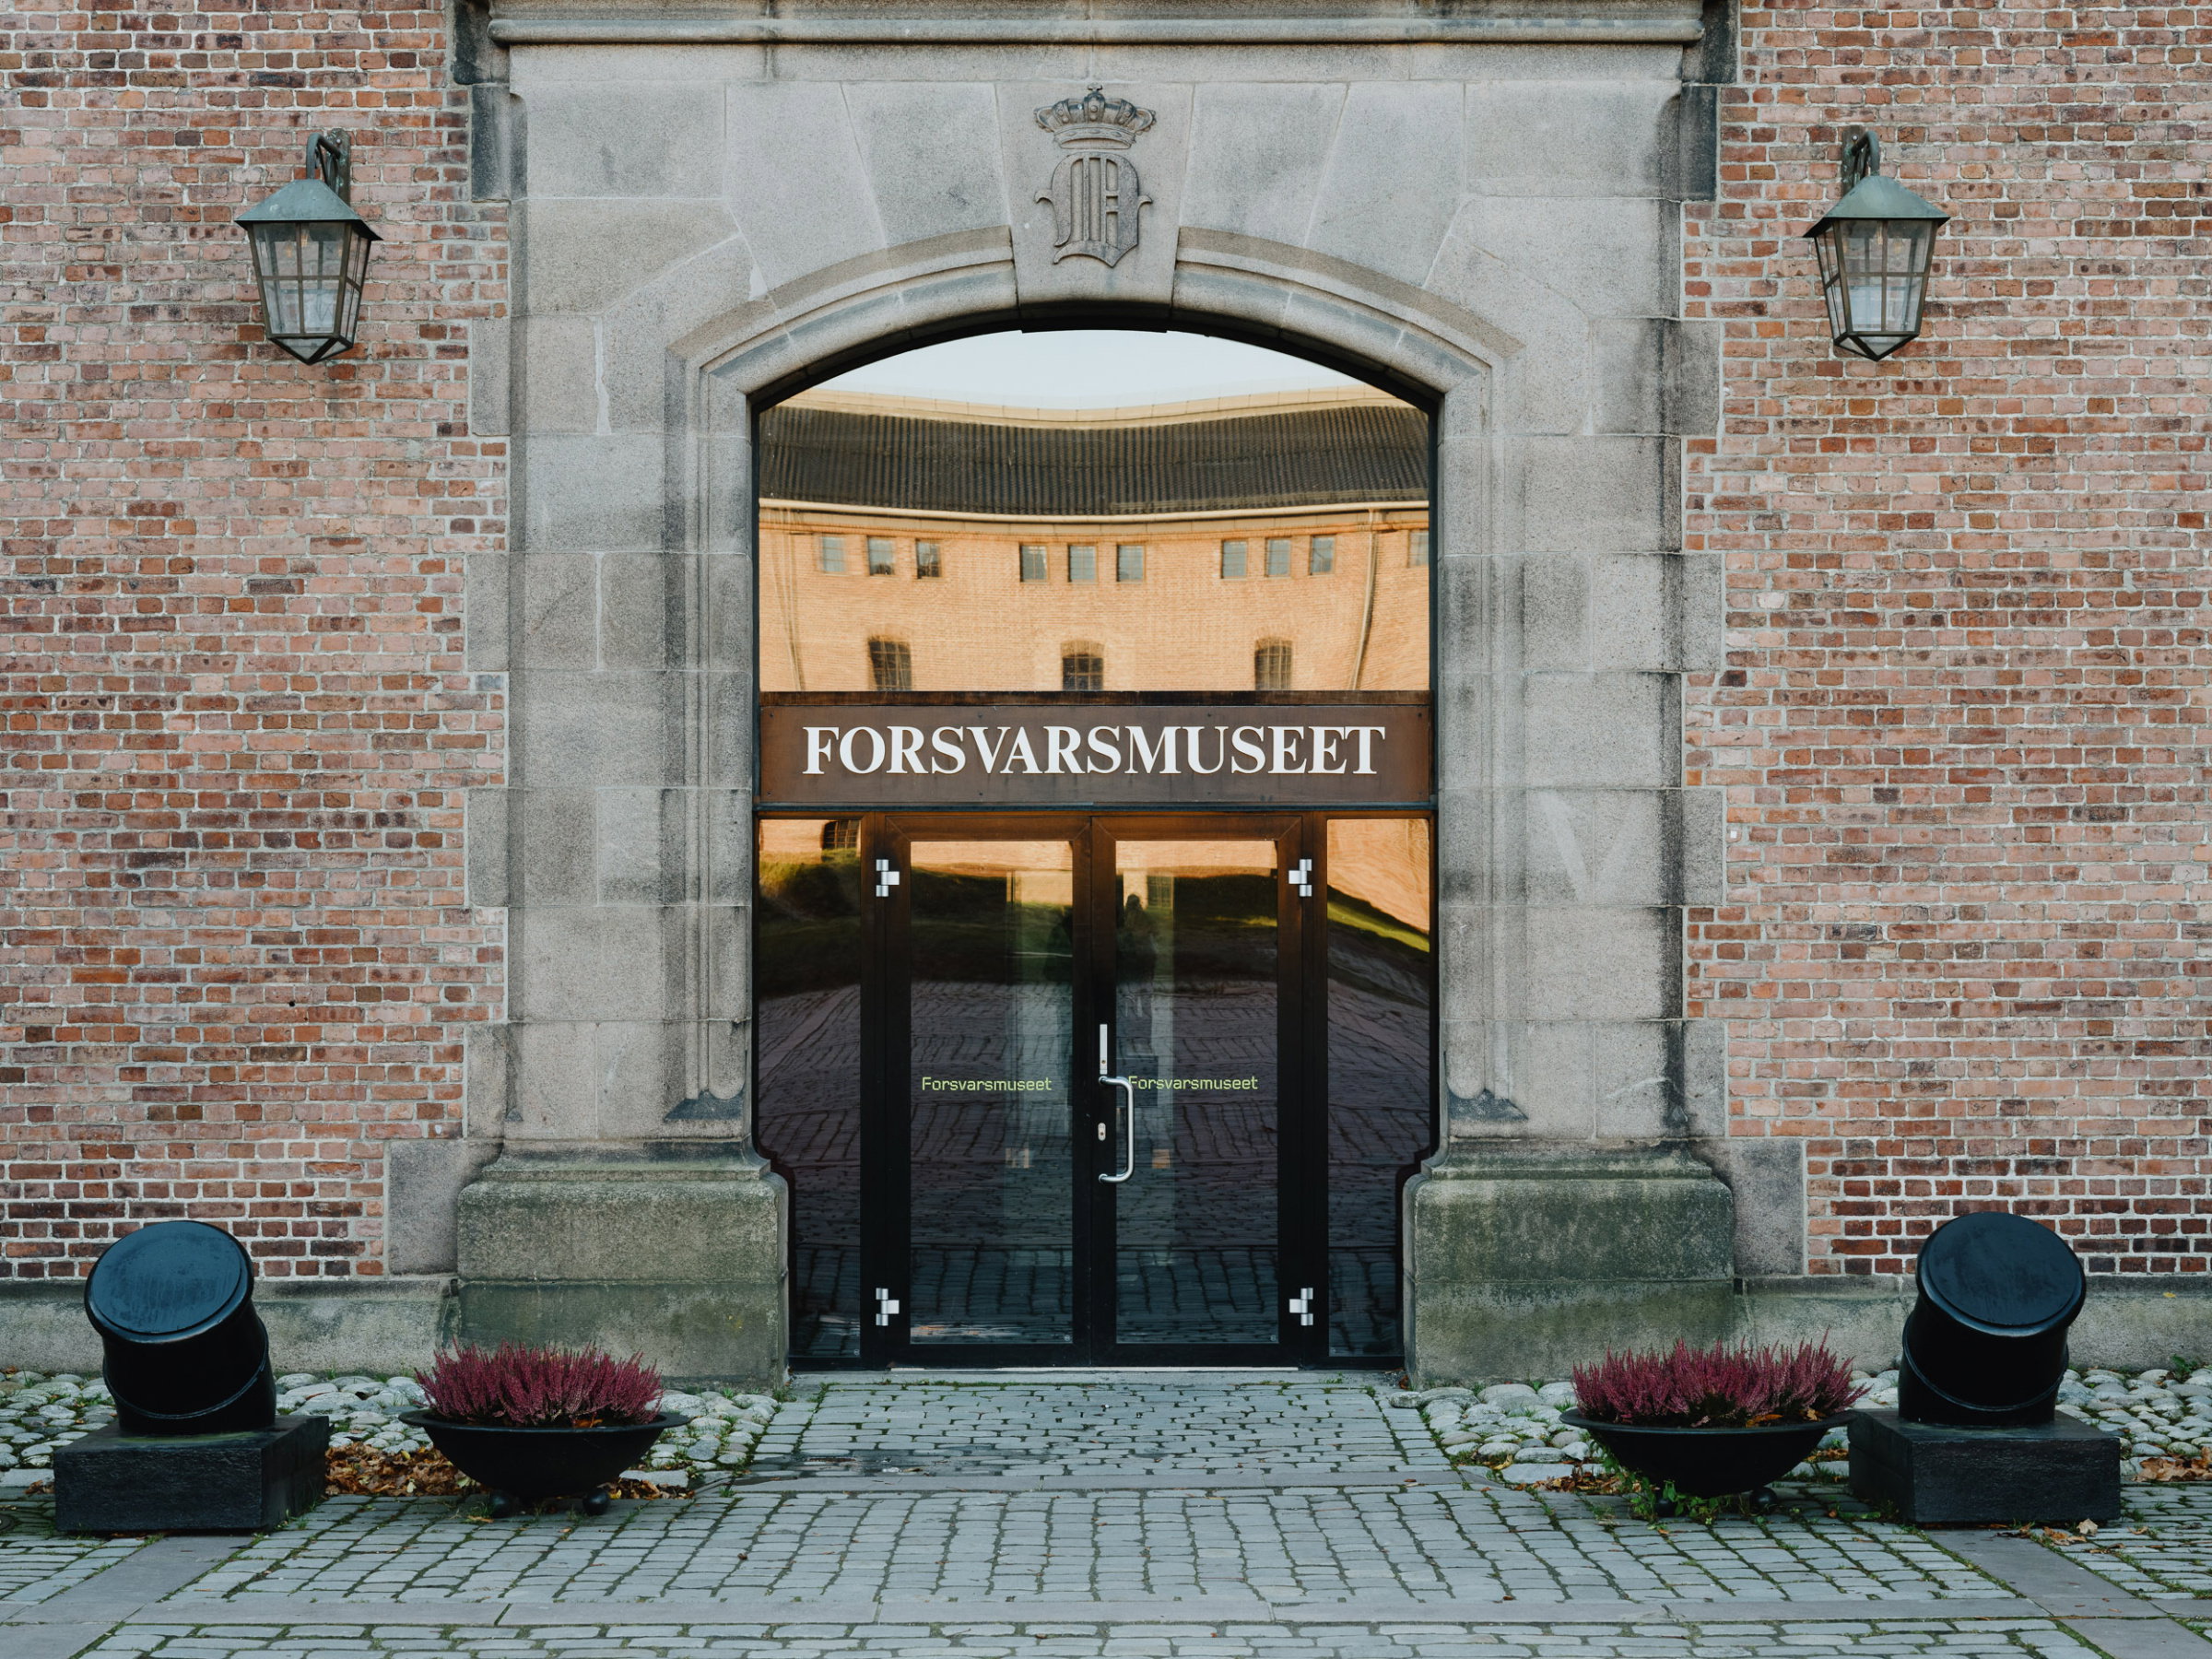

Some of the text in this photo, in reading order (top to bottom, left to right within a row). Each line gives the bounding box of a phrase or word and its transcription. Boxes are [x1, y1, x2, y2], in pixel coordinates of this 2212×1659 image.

[802, 724, 1386, 775] FORSVARSMUSEET
[922, 1076, 1052, 1091] Forsvarsmuseet
[1128, 1075, 1258, 1090] Forsvarsmuseet
